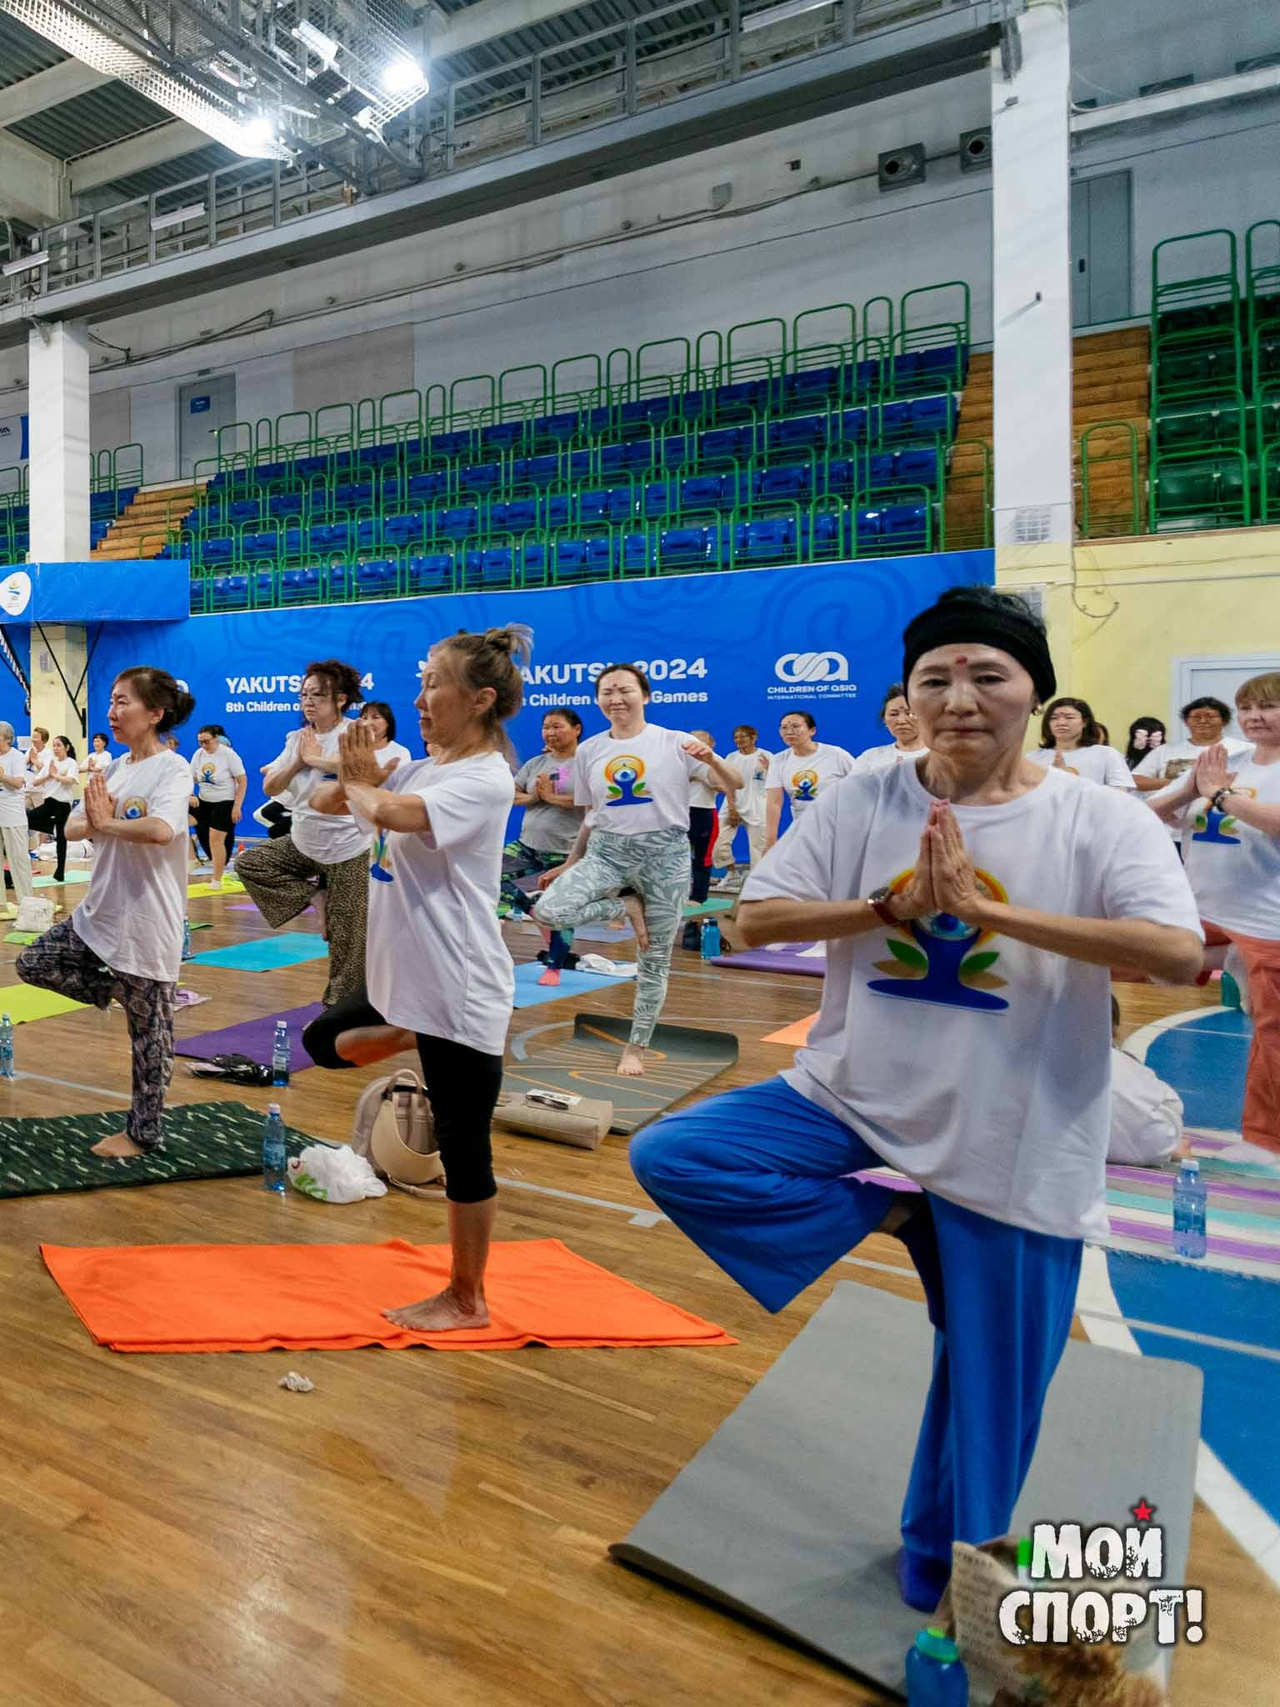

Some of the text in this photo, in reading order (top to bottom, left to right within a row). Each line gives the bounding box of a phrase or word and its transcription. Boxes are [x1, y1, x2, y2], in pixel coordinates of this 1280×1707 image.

[520, 662, 613, 685] AKUTS
[225, 674, 305, 694] YAKUTS
[767, 685, 815, 694] CHILDREN
[815, 685, 830, 693] OF
[225, 701, 244, 712] 8th
[246, 701, 291, 712] Children
[529, 693, 591, 707] Children
[651, 690, 708, 705] Games
